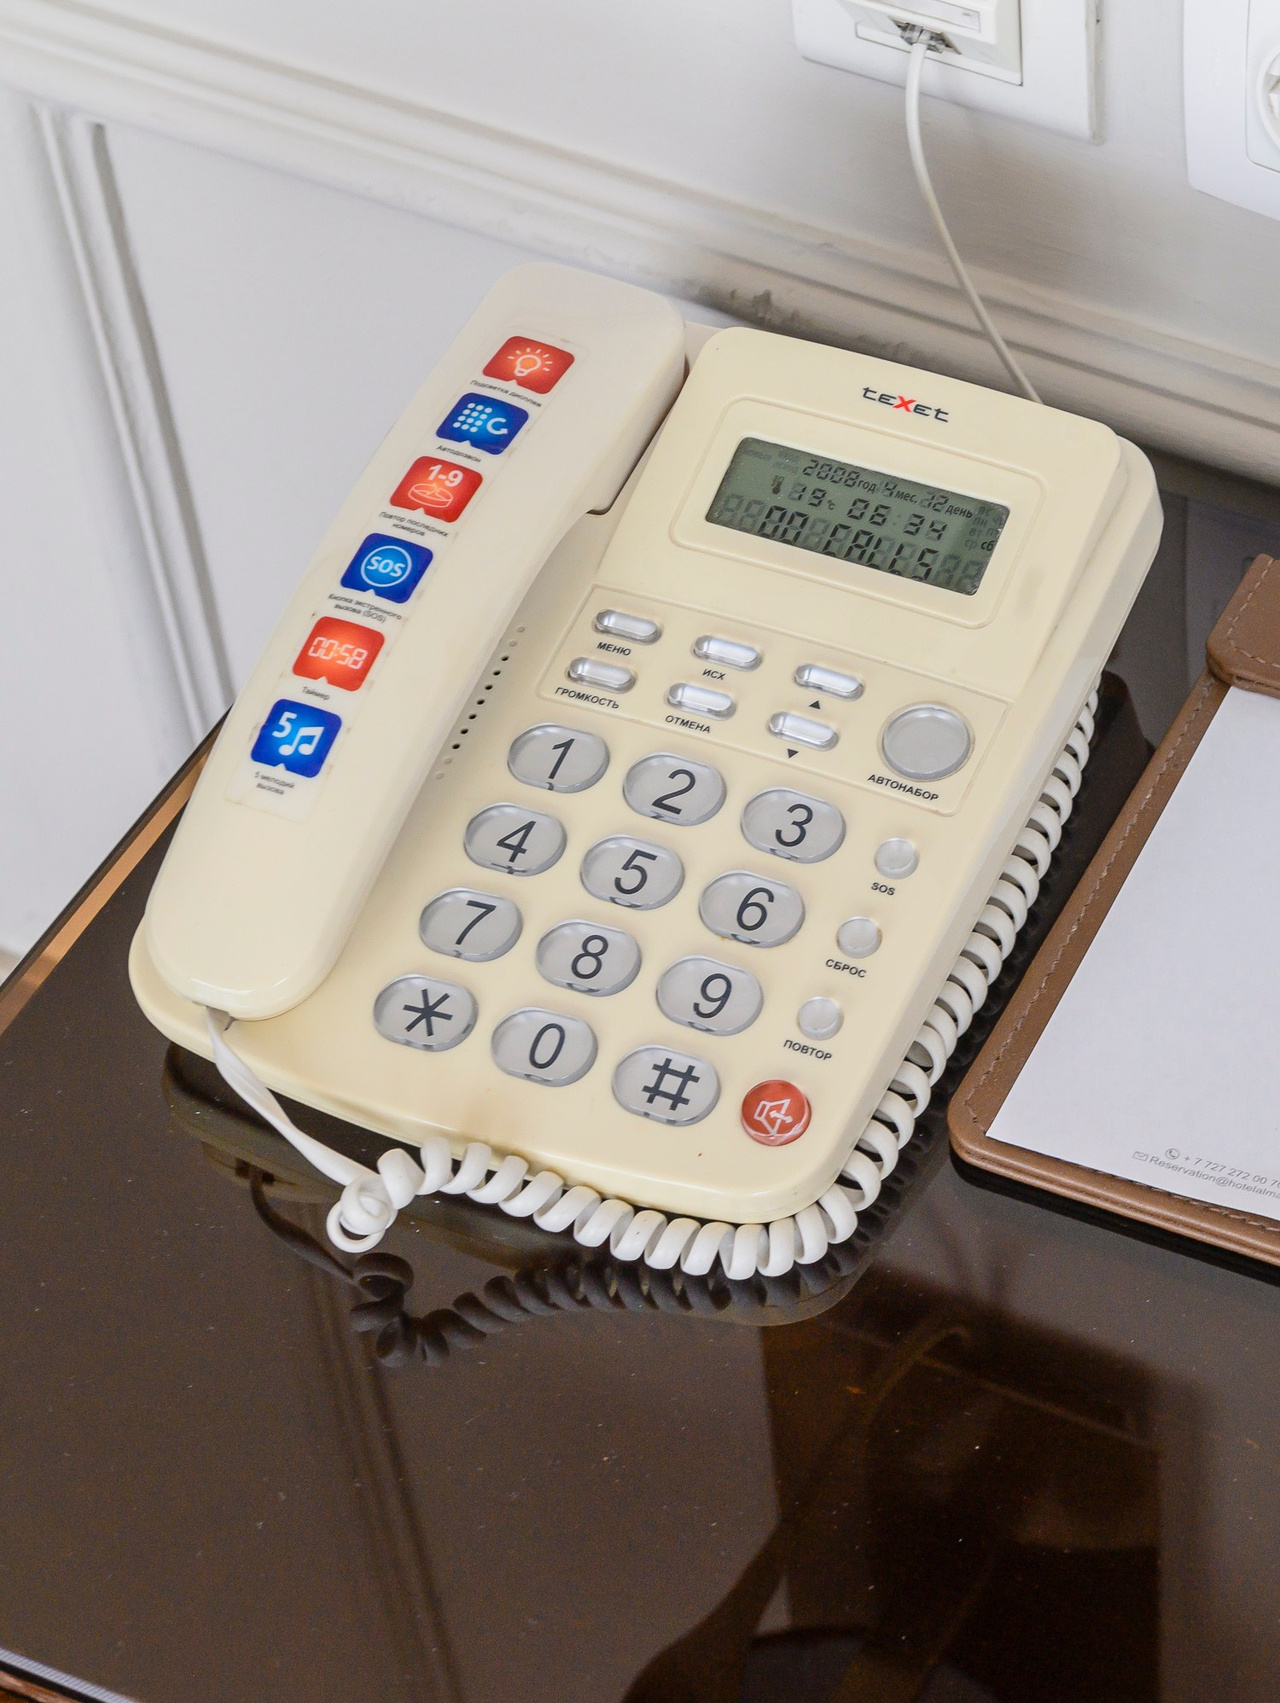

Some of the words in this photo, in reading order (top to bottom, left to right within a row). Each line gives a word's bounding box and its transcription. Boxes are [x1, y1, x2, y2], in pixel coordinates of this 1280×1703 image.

[427, 464, 463, 487] 1-9
[802, 459, 861, 488] 2008
[857, 479, 877, 494] год
[945, 504, 973, 519] день
[366, 556, 406, 578] SOS
[308, 637, 368, 670] 00:58
[596, 641, 632, 657] МЕНЮ
[702, 668, 727, 682] ИСХ
[555, 686, 620, 710] ГРОМКОСТЬ
[272, 711, 298, 738] 5
[664, 714, 712, 735] ОТМЕНА
[548, 737, 576, 781] 1
[652, 769, 697, 815] 2
[867, 773, 939, 802] АВТОНАБОР
[775, 803, 814, 848] 3
[497, 820, 537, 863] 4
[614, 850, 658, 896] 5
[871, 881, 896, 896] SOS
[456, 900, 497, 945] 7
[736, 887, 775, 932] 6
[571, 935, 610, 980] 8
[825, 958, 867, 979] СБРОС
[693, 973, 733, 1019] 9
[529, 1023, 567, 1070] 0
[783, 1039, 833, 1062] ПОВТОР
[1205, 1160, 1227, 1173] 727
[1230, 1168, 1250, 1180] 272
[1252, 1174, 1268, 1185] 00
